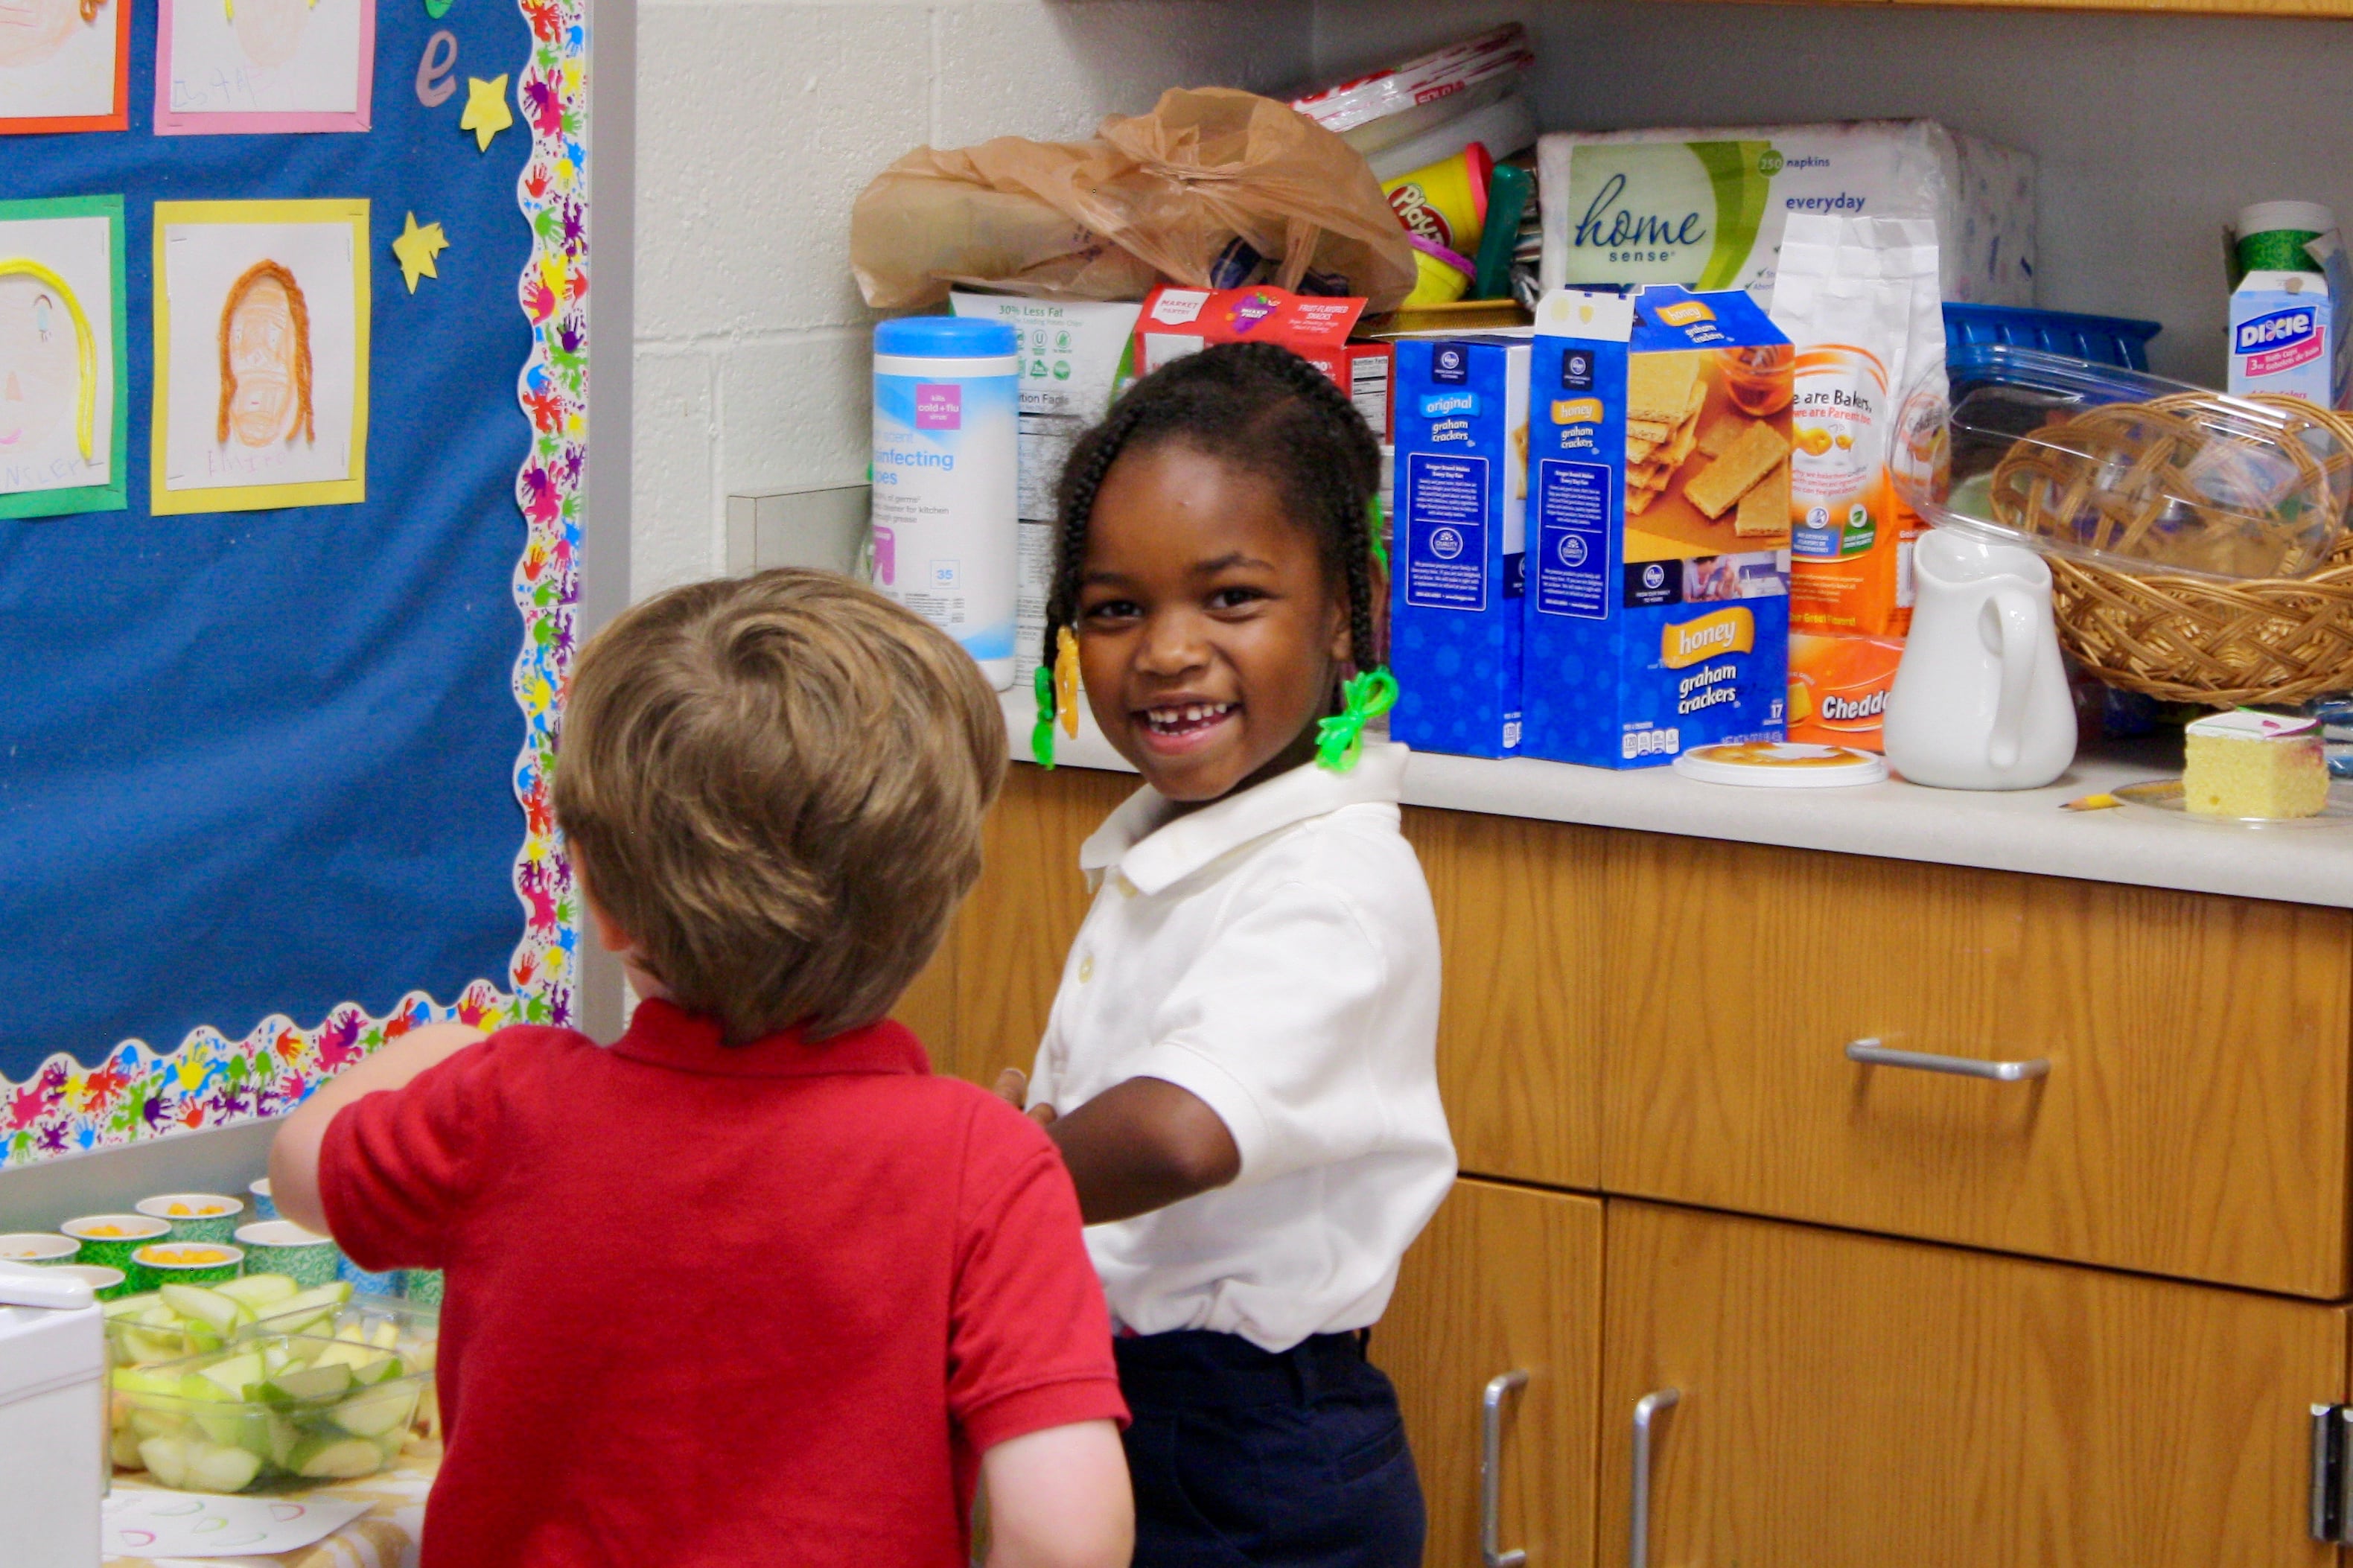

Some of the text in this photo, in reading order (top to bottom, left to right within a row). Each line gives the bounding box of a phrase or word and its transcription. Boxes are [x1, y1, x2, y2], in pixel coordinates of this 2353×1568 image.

[1787, 156, 1830, 170] napkins
[1786, 192, 1866, 213] everyday
[1575, 173, 1707, 247] home
[1609, 251, 1669, 261] sense
[1162, 299, 1198, 309] MARKET
[999, 305, 1063, 317] 30% Less Fat
[1667, 308, 1701, 321] honey
[1427, 395, 1472, 414] original
[1804, 393, 1830, 404] are
[918, 404, 938, 412] cold
[946, 404, 960, 412] flu
[1561, 405, 1592, 418] honey
[1809, 409, 1827, 418] are
[1432, 419, 1468, 434] graham
[1432, 430, 1468, 442] crackers
[1561, 426, 1593, 441] graham
[1561, 437, 1593, 449] crackers
[919, 506, 949, 514] kitchen
[937, 570, 953, 580] 35
[1679, 622, 1736, 655] honey
[1679, 665, 1736, 698] graham
[1678, 686, 1736, 716] crackers
